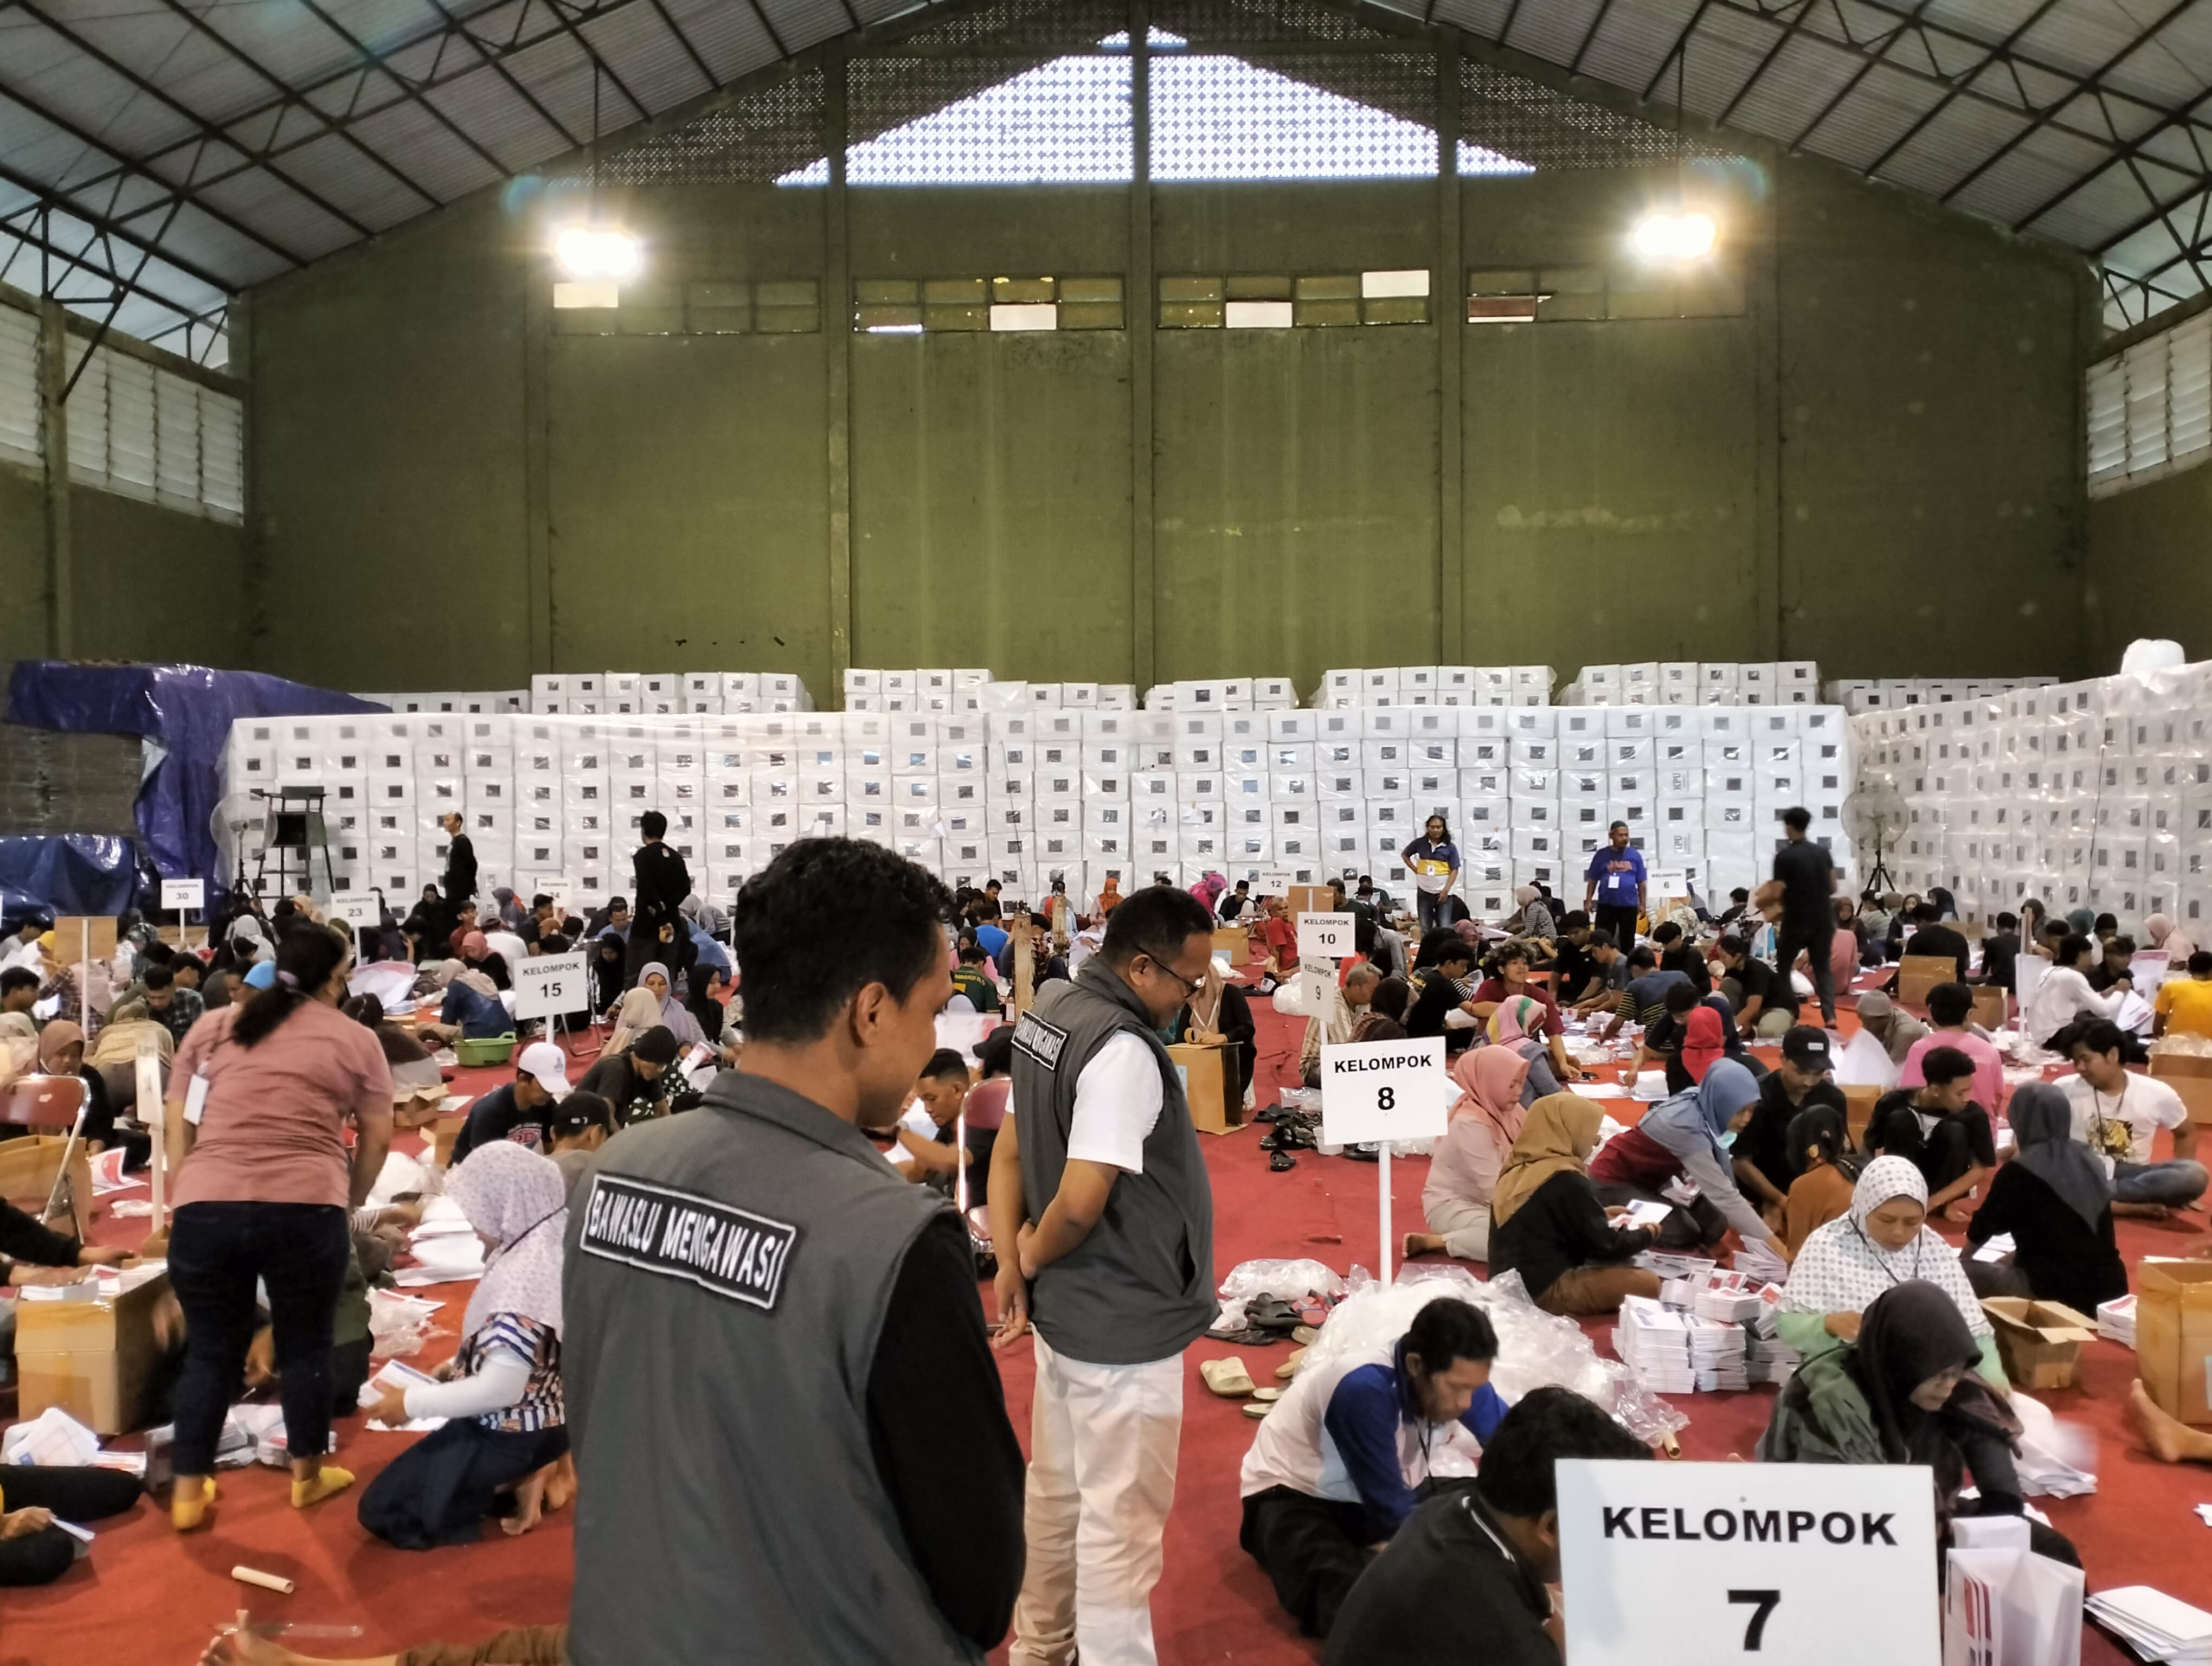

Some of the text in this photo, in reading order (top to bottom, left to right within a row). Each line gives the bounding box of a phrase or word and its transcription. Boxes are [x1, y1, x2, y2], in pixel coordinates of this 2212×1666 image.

[348, 908, 363, 917] 23
[1304, 918, 1349, 926] KELOMPOK
[1318, 933, 1336, 944] 10
[523, 962, 580, 976] KELOMPOK
[1304, 963, 1332, 979] KELOMPOK
[539, 982, 562, 998] 15
[1315, 985, 1322, 1001] 9
[1334, 1054, 1432, 1074] KELOMPOK
[1377, 1086, 1396, 1111] 8
[588, 1189, 784, 1292] BAWASLU MENGAWASI
[1603, 1506, 1899, 1546] KELOMPOK
[1727, 1589, 1781, 1651] 7
